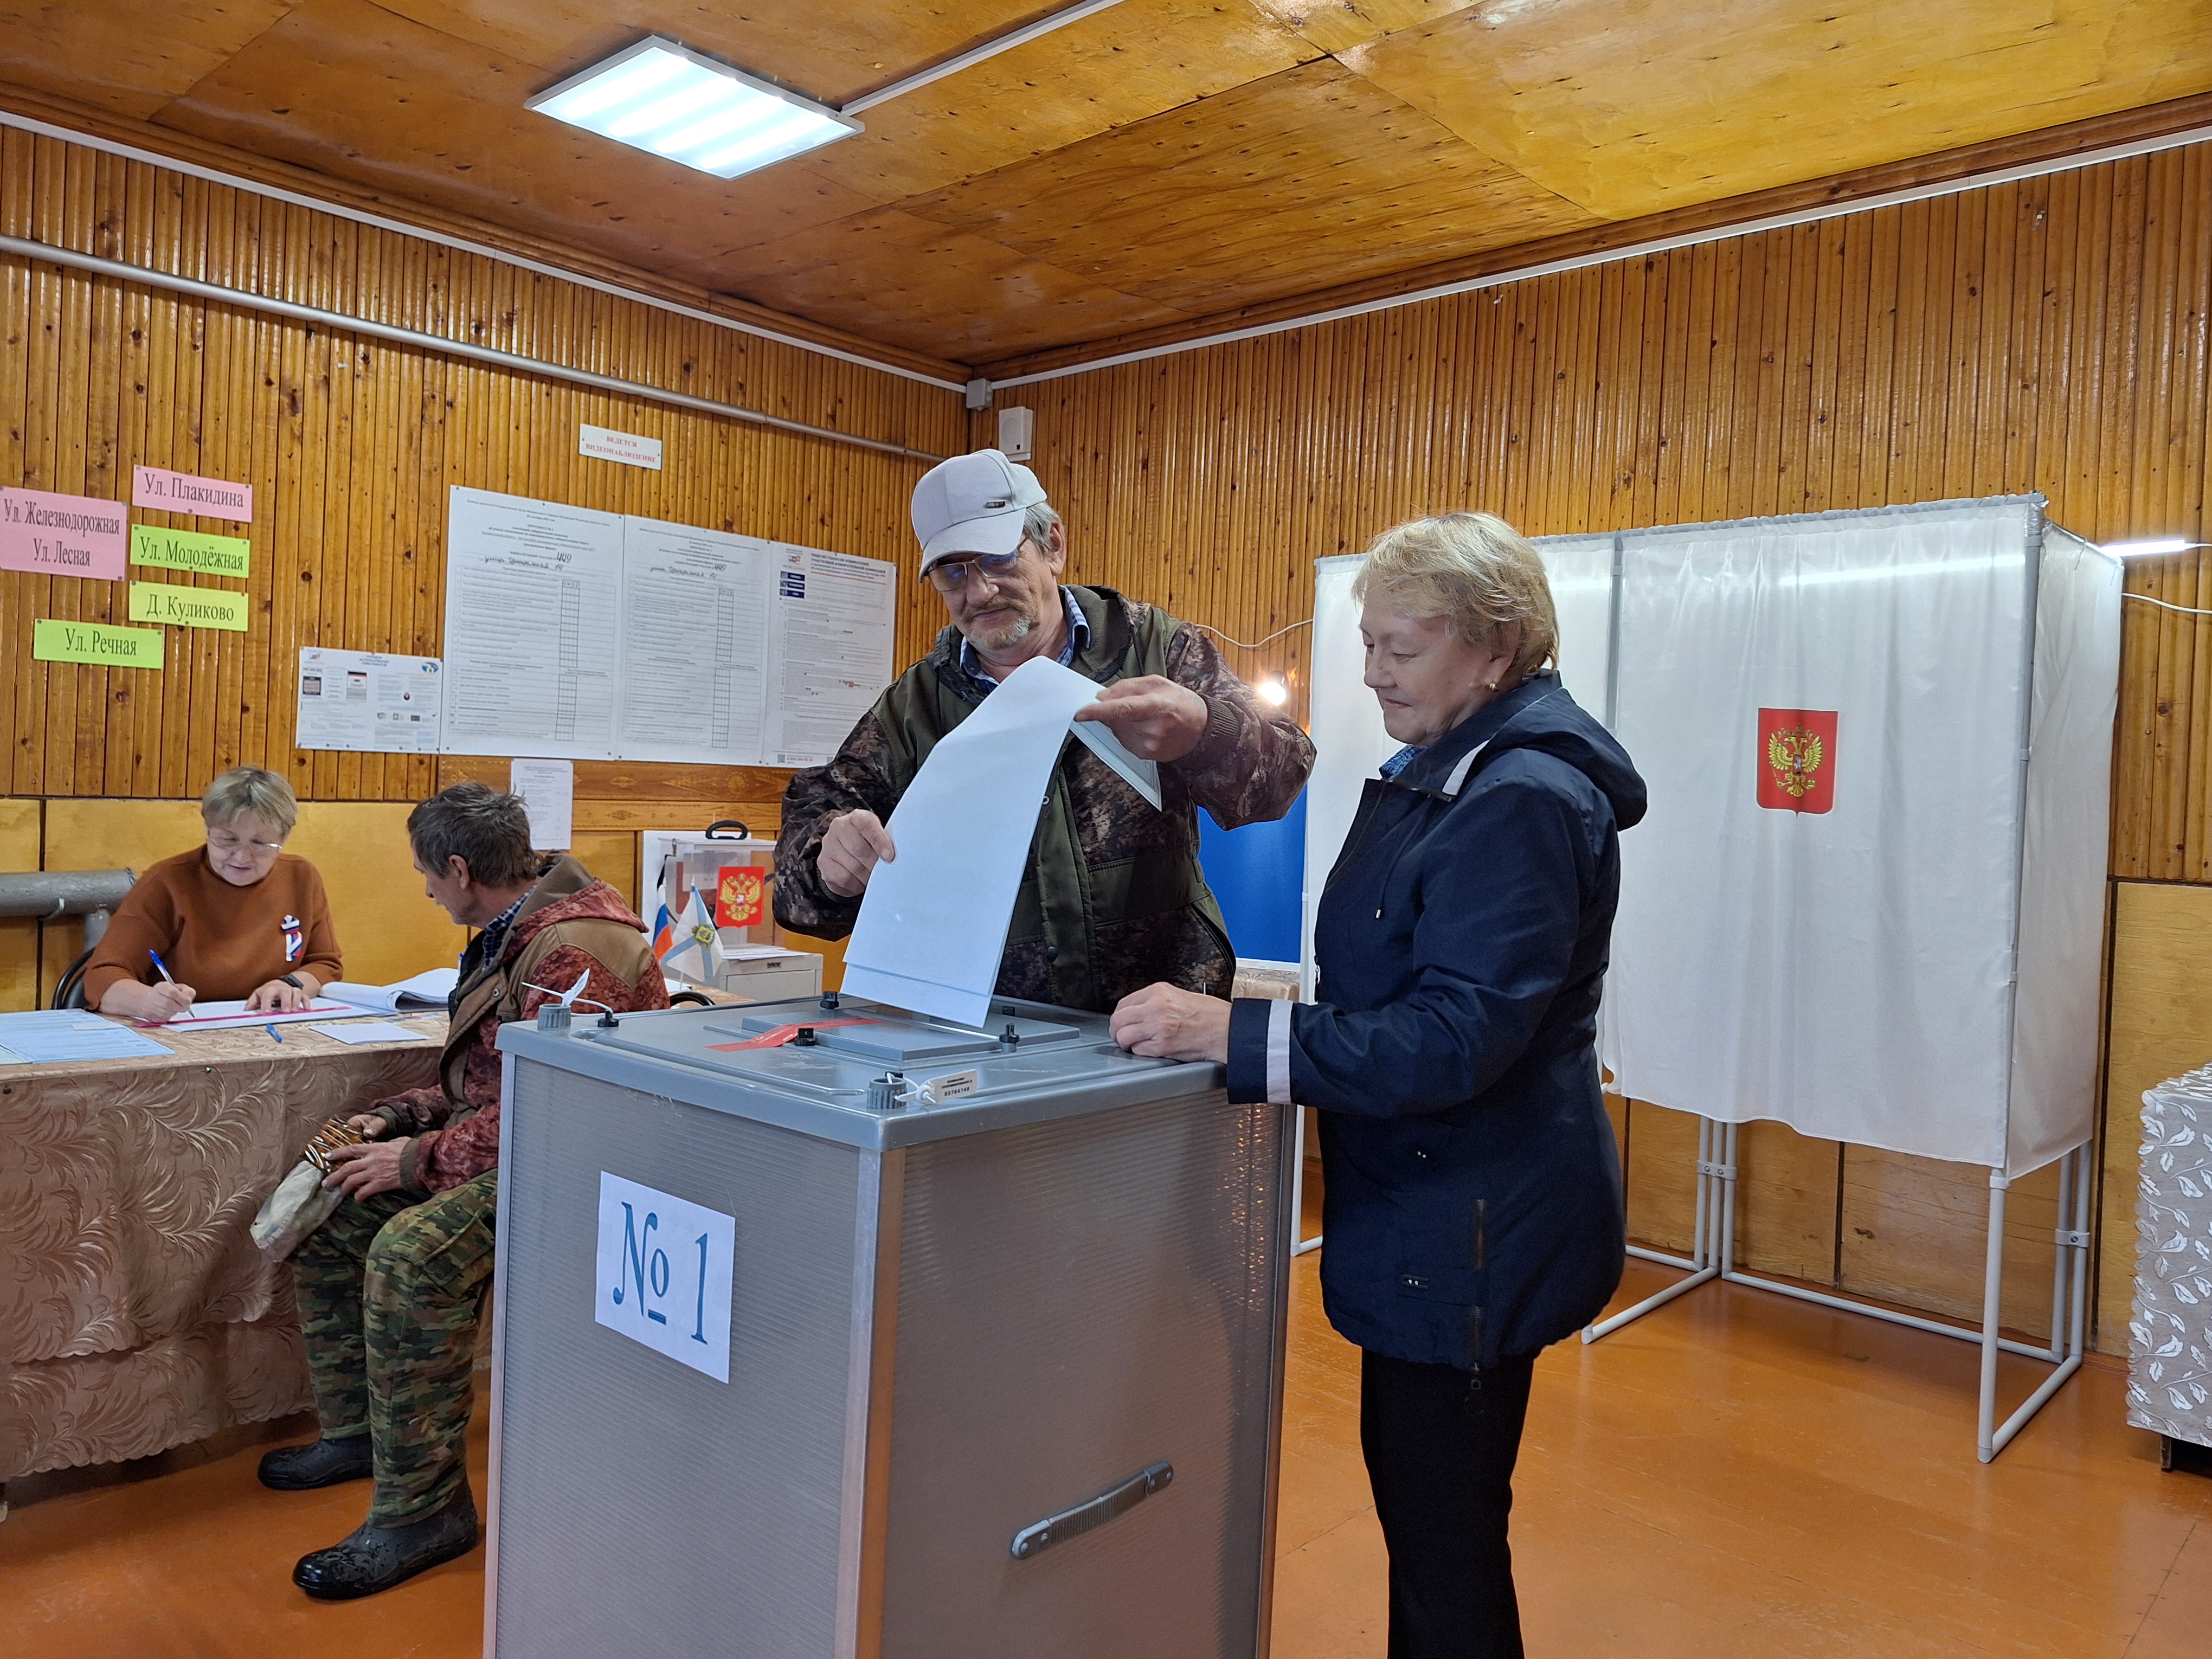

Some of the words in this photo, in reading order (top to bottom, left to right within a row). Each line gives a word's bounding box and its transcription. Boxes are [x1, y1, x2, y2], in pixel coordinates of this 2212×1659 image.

[586, 443, 656, 462] ВИДЕОНАБЛЮДЕНИЕ
[607, 436, 637, 448] ВЕДЕТСЯ
[145, 473, 166, 497] Ул.
[171, 477, 243, 507] Плакидина
[4, 498, 21, 523] Ул.
[25, 500, 119, 537] Железнодорожная
[33, 538, 50, 562] Ул.
[54, 541, 90, 566] Лесная
[140, 536, 160, 560] Ул.
[165, 539, 243, 570] Молодёжная
[557, 552, 572, 563] 449
[714, 563, 727, 572] 449
[146, 594, 162, 618] Д.
[167, 595, 234, 621] Куликово
[65, 628, 86, 652] Ул.
[92, 630, 137, 656] Речная
[613, 1201, 670, 1326] №
[691, 1232, 708, 1345] 1
